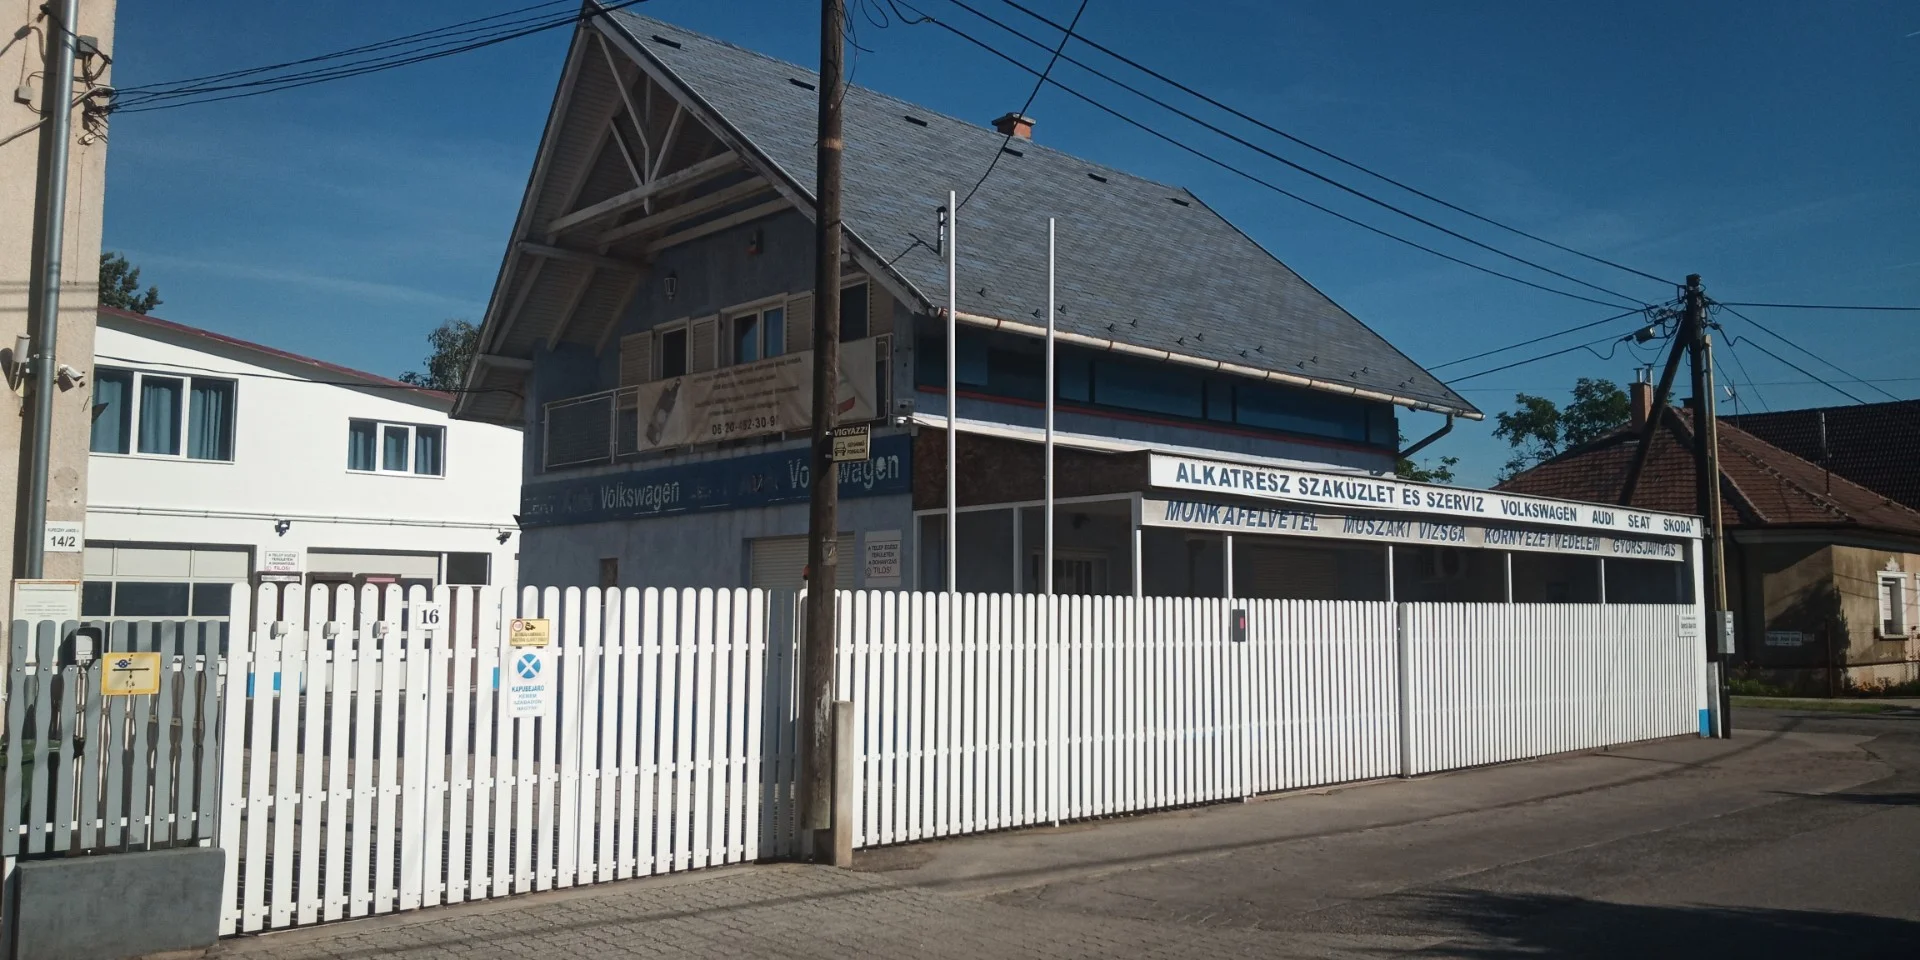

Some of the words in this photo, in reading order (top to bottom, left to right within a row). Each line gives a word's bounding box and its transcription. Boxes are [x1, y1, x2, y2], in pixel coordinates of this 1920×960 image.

[601, 481, 680, 510] Volkswagen
[788, 454, 899, 489] Vowagen
[1175, 462, 1291, 494] ALKATRÉSZ
[1298, 475, 1396, 504] SZAKÜZLET
[1402, 483, 1421, 506] ÉS
[1426, 491, 1485, 513] SZERVIZ
[1501, 499, 1578, 523] VOLKSWAGEN
[1592, 509, 1615, 527] AUDI
[1628, 514, 1651, 530] SEAT
[50, 535, 76, 547] 14/2
[1419, 521, 1466, 542] VIZSGA
[421, 609, 440, 624] 16
